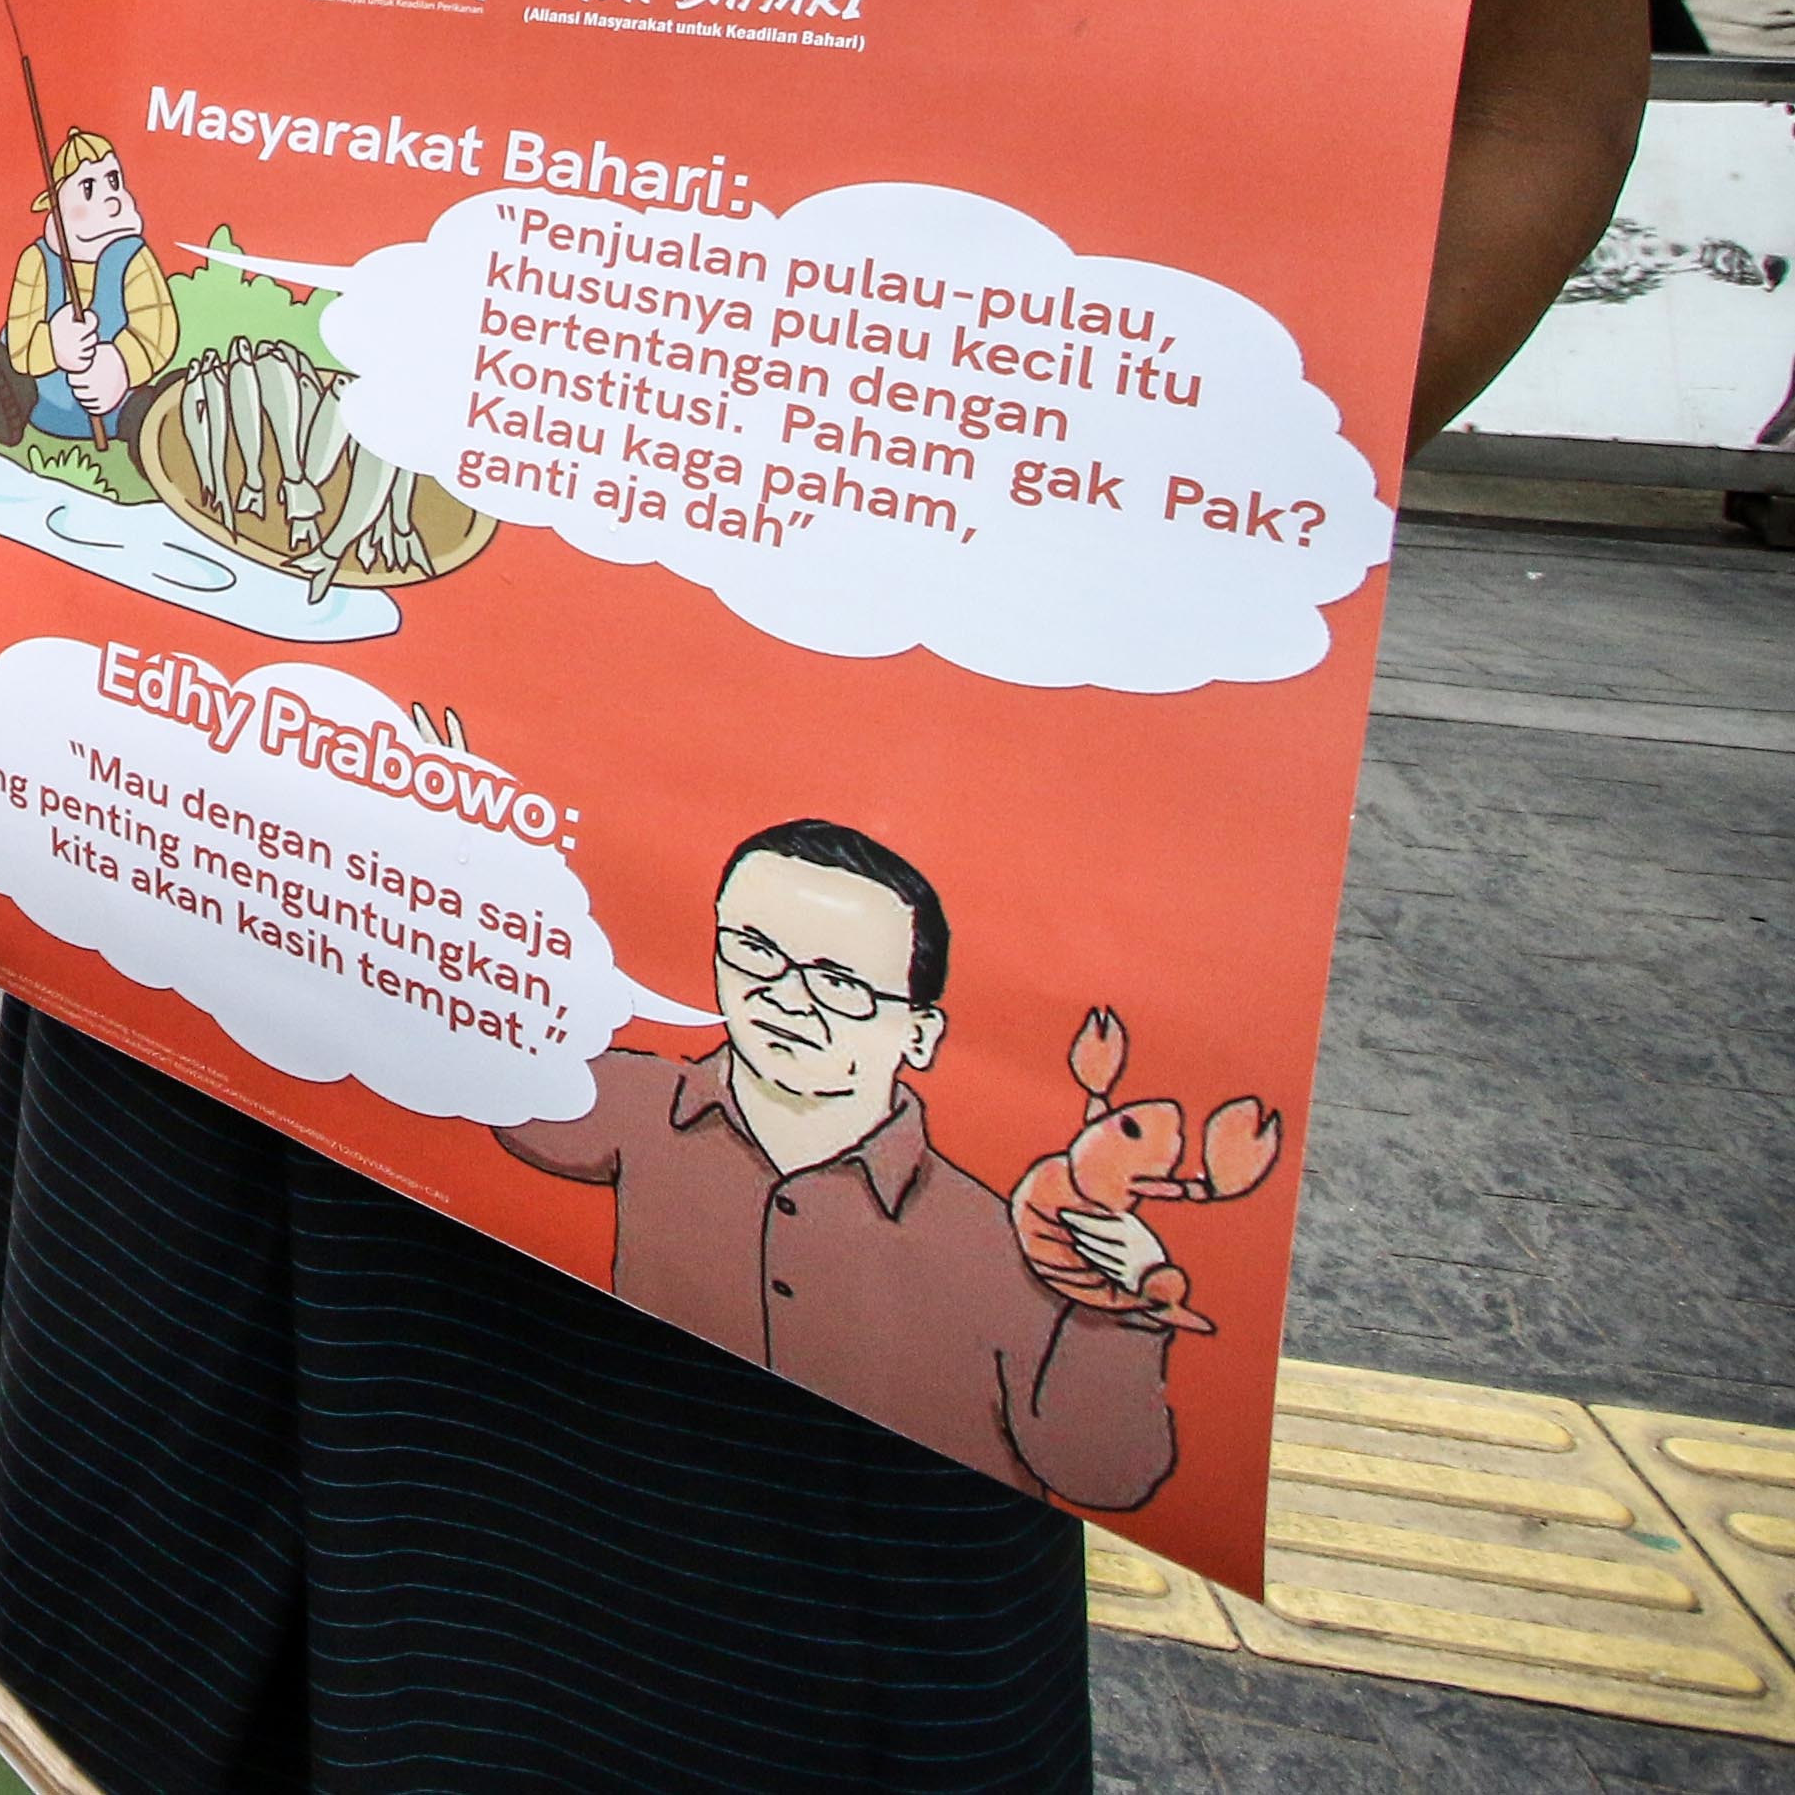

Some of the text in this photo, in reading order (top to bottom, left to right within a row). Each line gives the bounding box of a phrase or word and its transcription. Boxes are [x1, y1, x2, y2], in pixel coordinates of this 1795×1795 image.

[523, 6, 867, 53] (Aliansi Masyarakat untuk Keadilan Bahari)
[146, 85, 749, 213] Masyarakat Bahari:
[486, 251, 1202, 408] khususnya pulau kecil itu
[495, 203, 1176, 354] "Penjualan pulau-pulau,
[474, 345, 1327, 548] Konstitusi. Paham gak Pak?
[480, 298, 1067, 441] bertentangan dengan
[457, 448, 816, 547] ganti aja dah"
[467, 392, 977, 544] Kalau kaga paham,
[102, 641, 579, 851] Edhy Prabowo:
[39, 785, 182, 869] penting
[193, 844, 567, 1020] menguntungkan,
[68, 740, 572, 960] "Mau dengan siapa saja
[51, 825, 567, 1056] kita akan kasih tempat."
